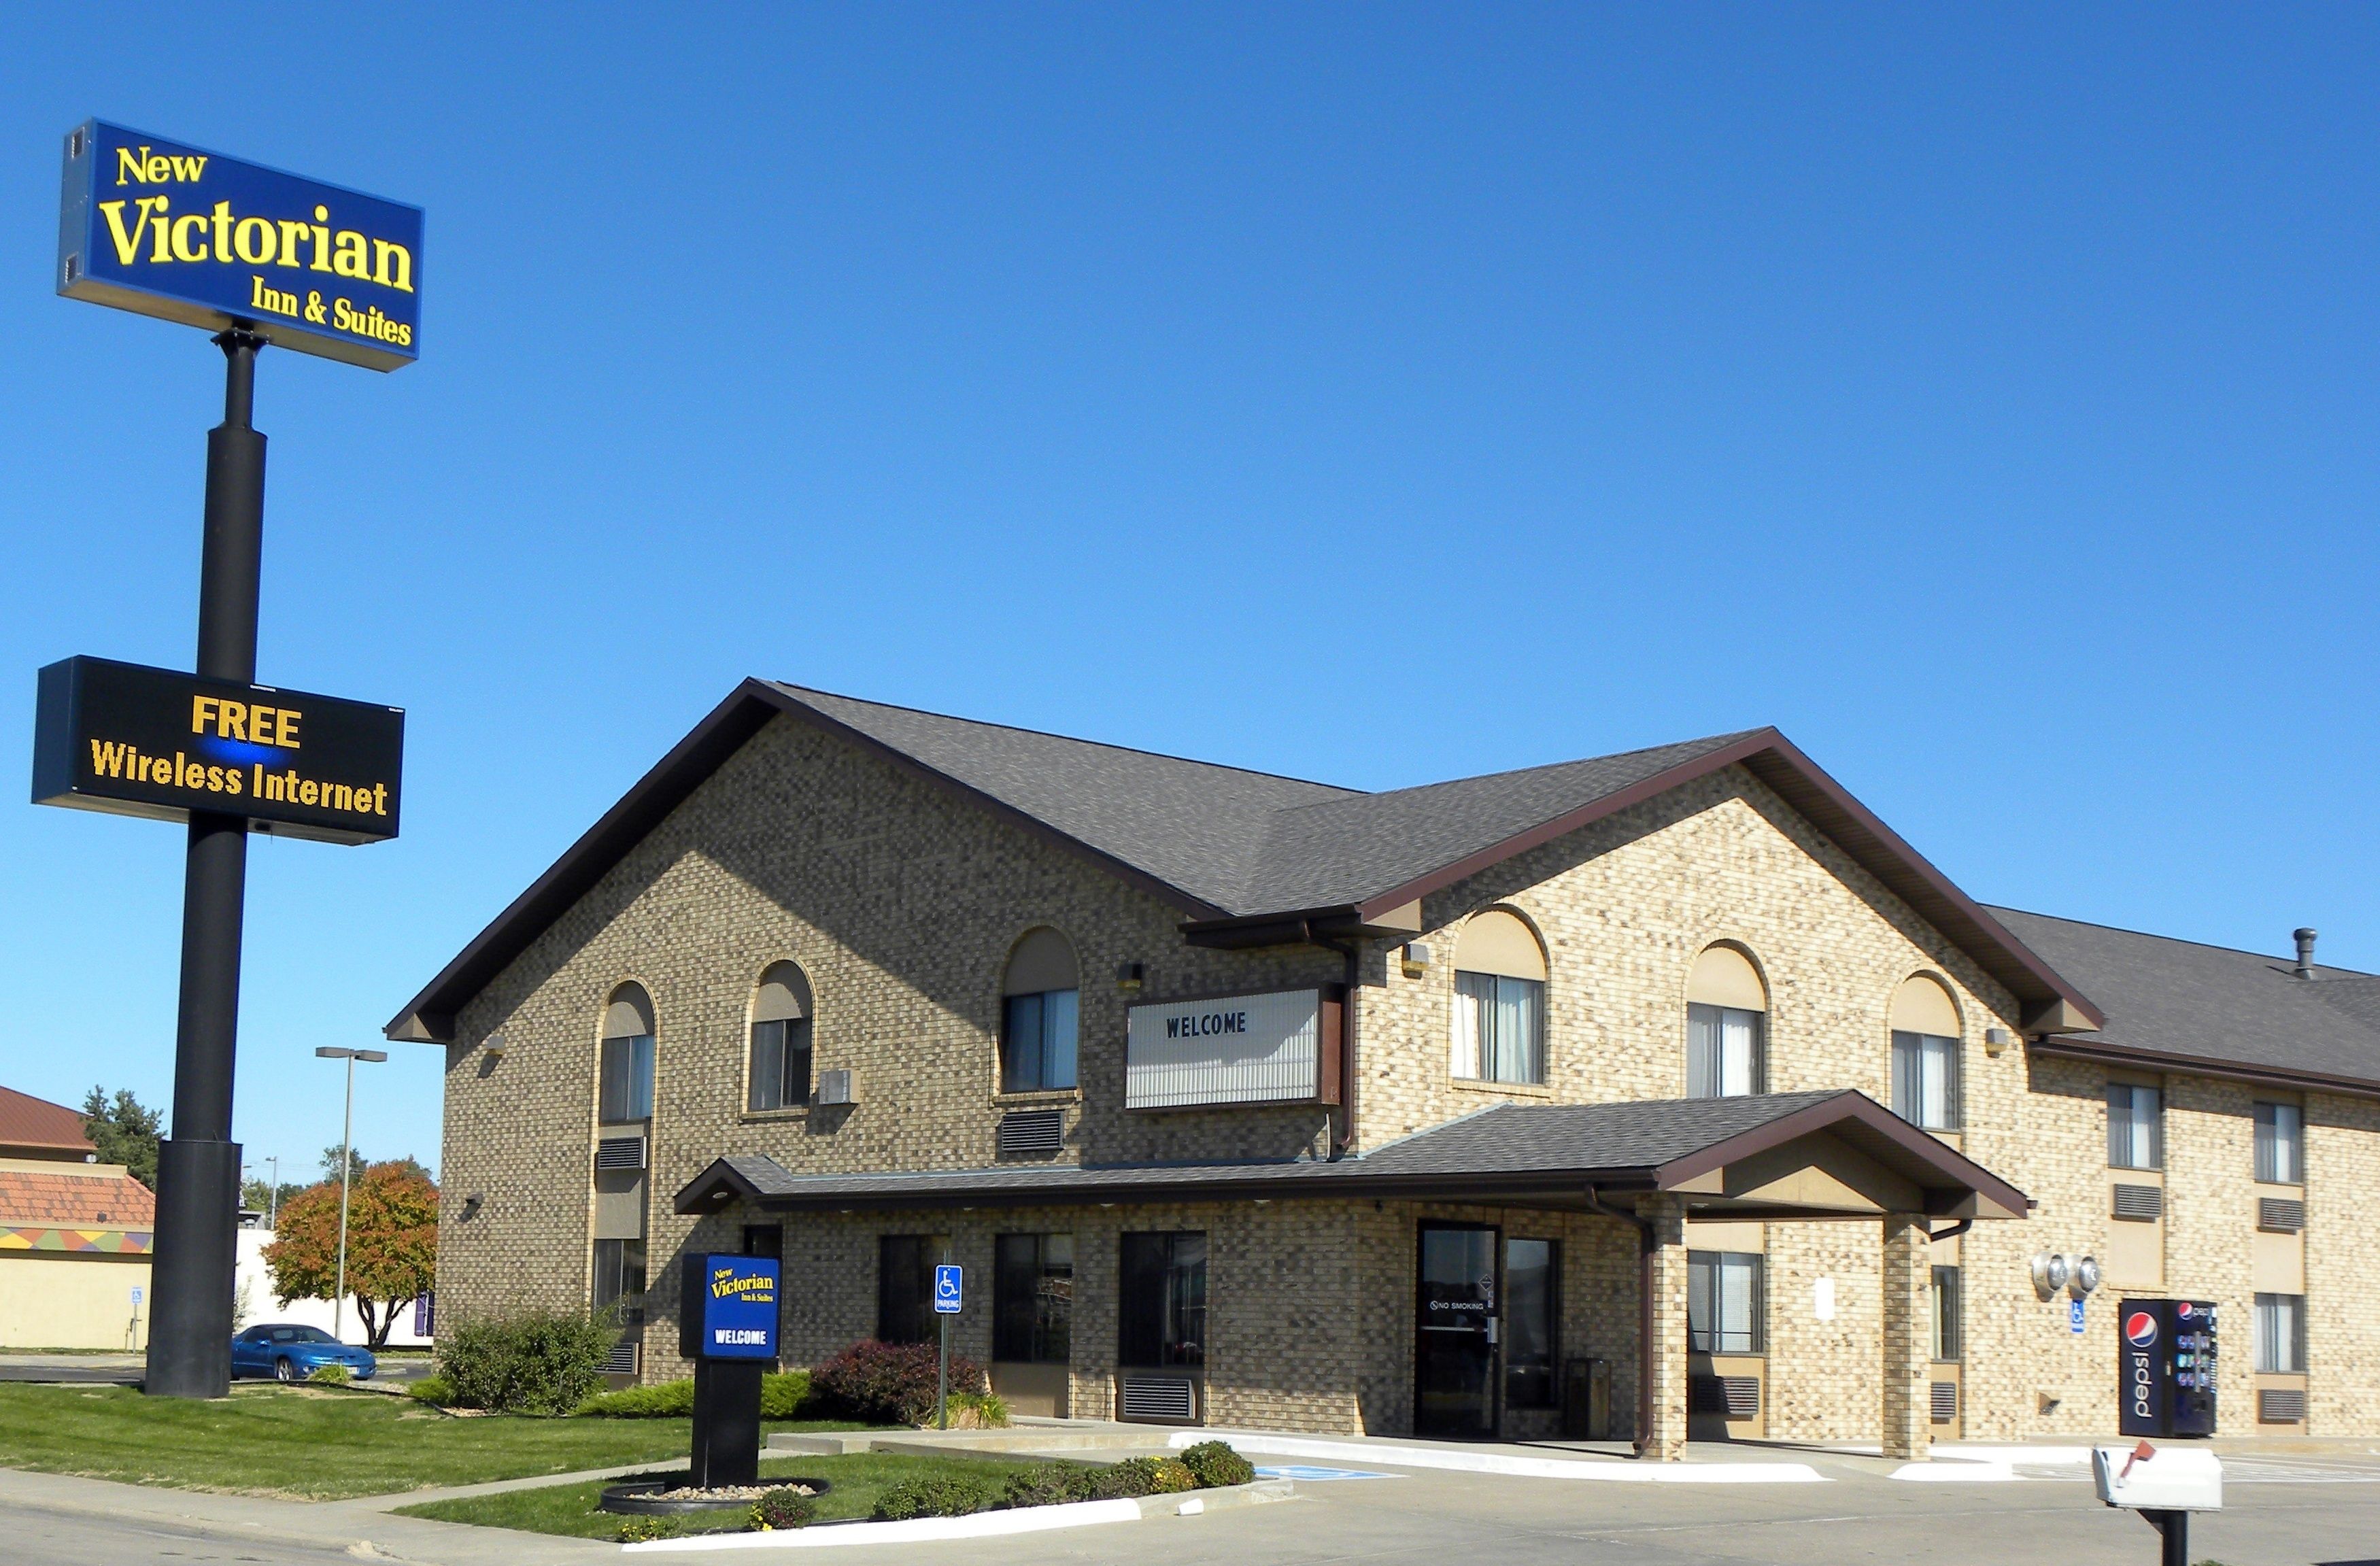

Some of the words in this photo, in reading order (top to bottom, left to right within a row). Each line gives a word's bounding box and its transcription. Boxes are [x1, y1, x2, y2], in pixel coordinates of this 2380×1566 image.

[116, 146, 207, 186] New
[99, 194, 413, 293] Victorian
[251, 275, 298, 317] Inn
[304, 290, 327, 324] &
[333, 298, 412, 346] Suites
[192, 695, 302, 749] FREE
[90, 738, 243, 795] Wireless
[253, 764, 388, 816] Internet
[1167, 1011, 1246, 1038] WELCOME
[711, 1273, 774, 1299] Victorian
[715, 1268, 733, 1281] New
[937, 1299, 959, 1308] PARKING
[1450, 1302, 1484, 1310] SMOKING
[715, 1329, 766, 1345] WELCOME
[2131, 1352, 2153, 1418] pepsi
